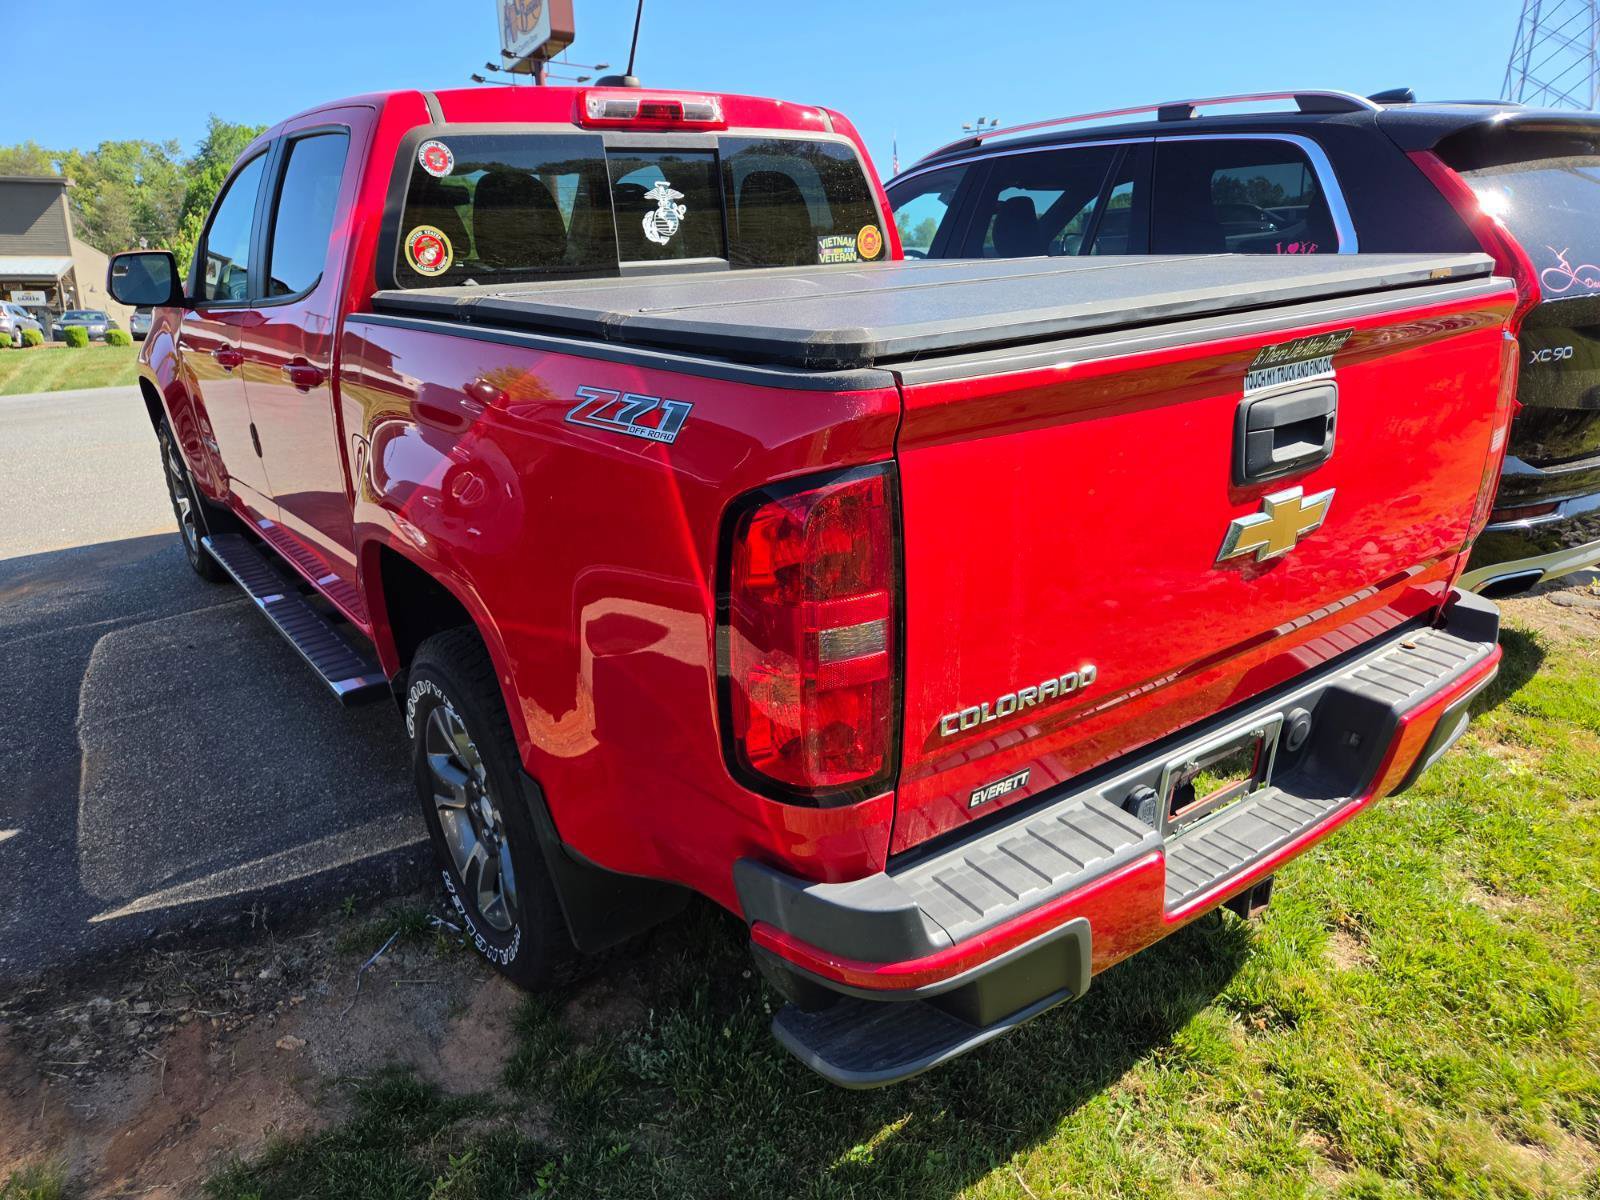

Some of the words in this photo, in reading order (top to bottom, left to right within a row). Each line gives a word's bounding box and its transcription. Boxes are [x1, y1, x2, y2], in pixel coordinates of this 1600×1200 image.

[424, 230, 442, 239] STATES
[819, 236, 856, 249] VIETNAM
[819, 251, 857, 264] VETERAN
[1261, 347, 1289, 364] There
[1285, 341, 1305, 360] Life
[1529, 346, 1573, 364] XC90
[1266, 368, 1275, 385] MY
[1275, 364, 1296, 383] TRUCK
[1297, 361, 1308, 379] AND
[1309, 358, 1321, 376] FIND
[565, 384, 694, 441] Z71
[628, 425, 646, 435] OFF
[647, 430, 674, 441] ROAD
[940, 664, 1097, 737] COLORADO
[970, 771, 1030, 808] EVERETT
